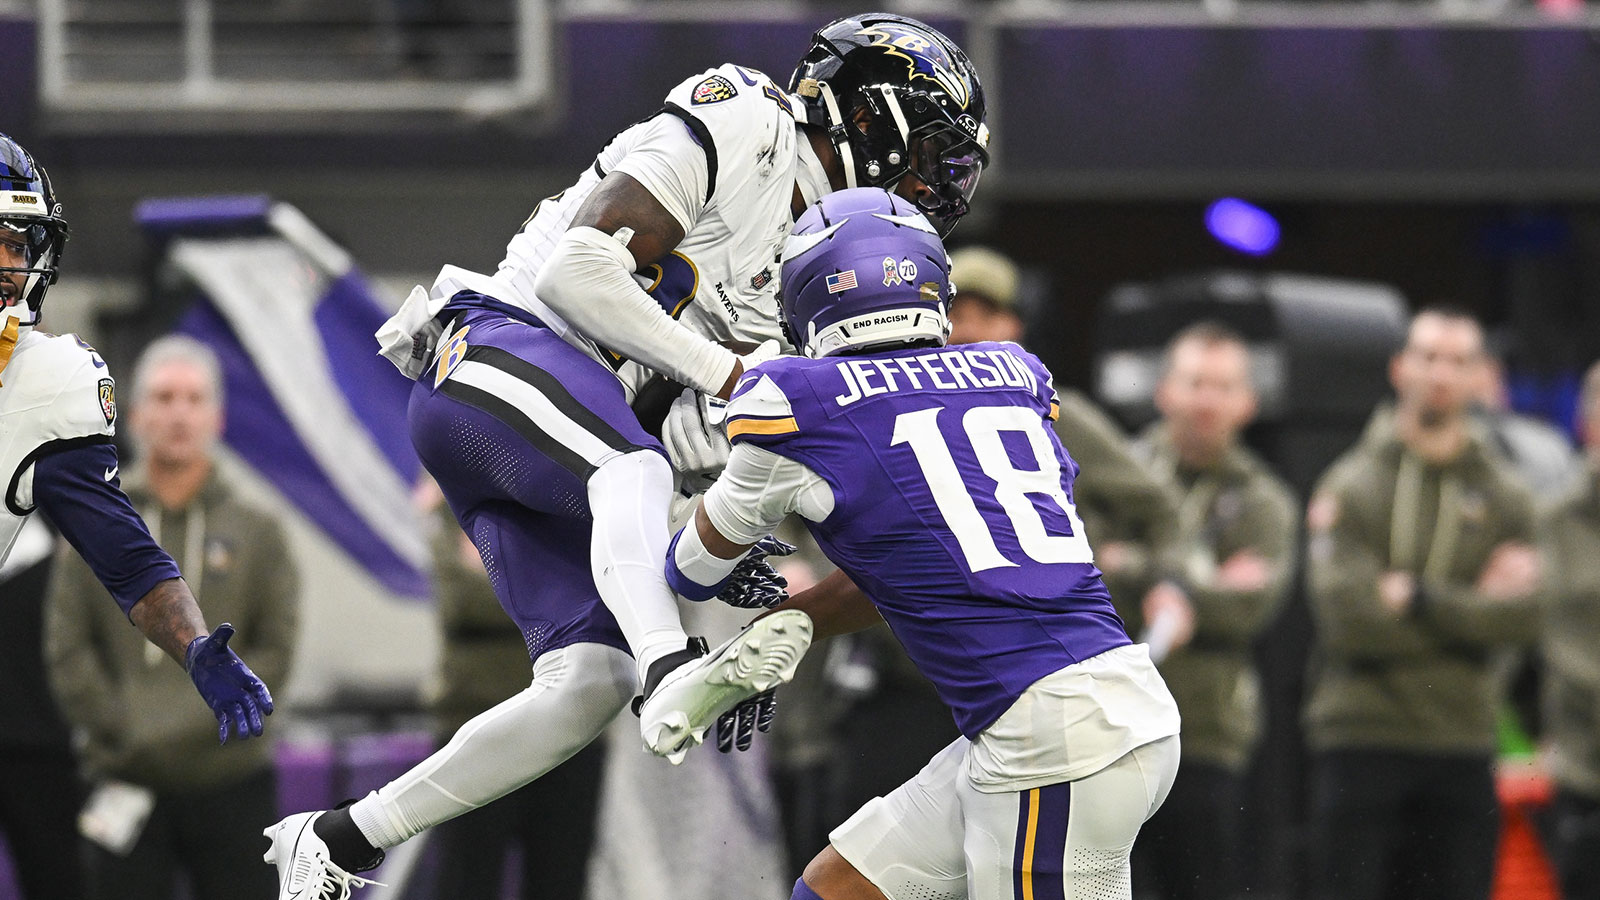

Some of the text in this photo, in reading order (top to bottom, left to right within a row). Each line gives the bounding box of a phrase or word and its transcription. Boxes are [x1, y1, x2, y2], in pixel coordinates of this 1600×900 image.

[12, 195, 37, 204] RAVENS
[902, 264, 915, 276] 70
[715, 281, 740, 322] RAVENS
[853, 314, 909, 329] END RACISM
[835, 349, 1038, 407] JEFFERSON
[890, 405, 1094, 574] 18
